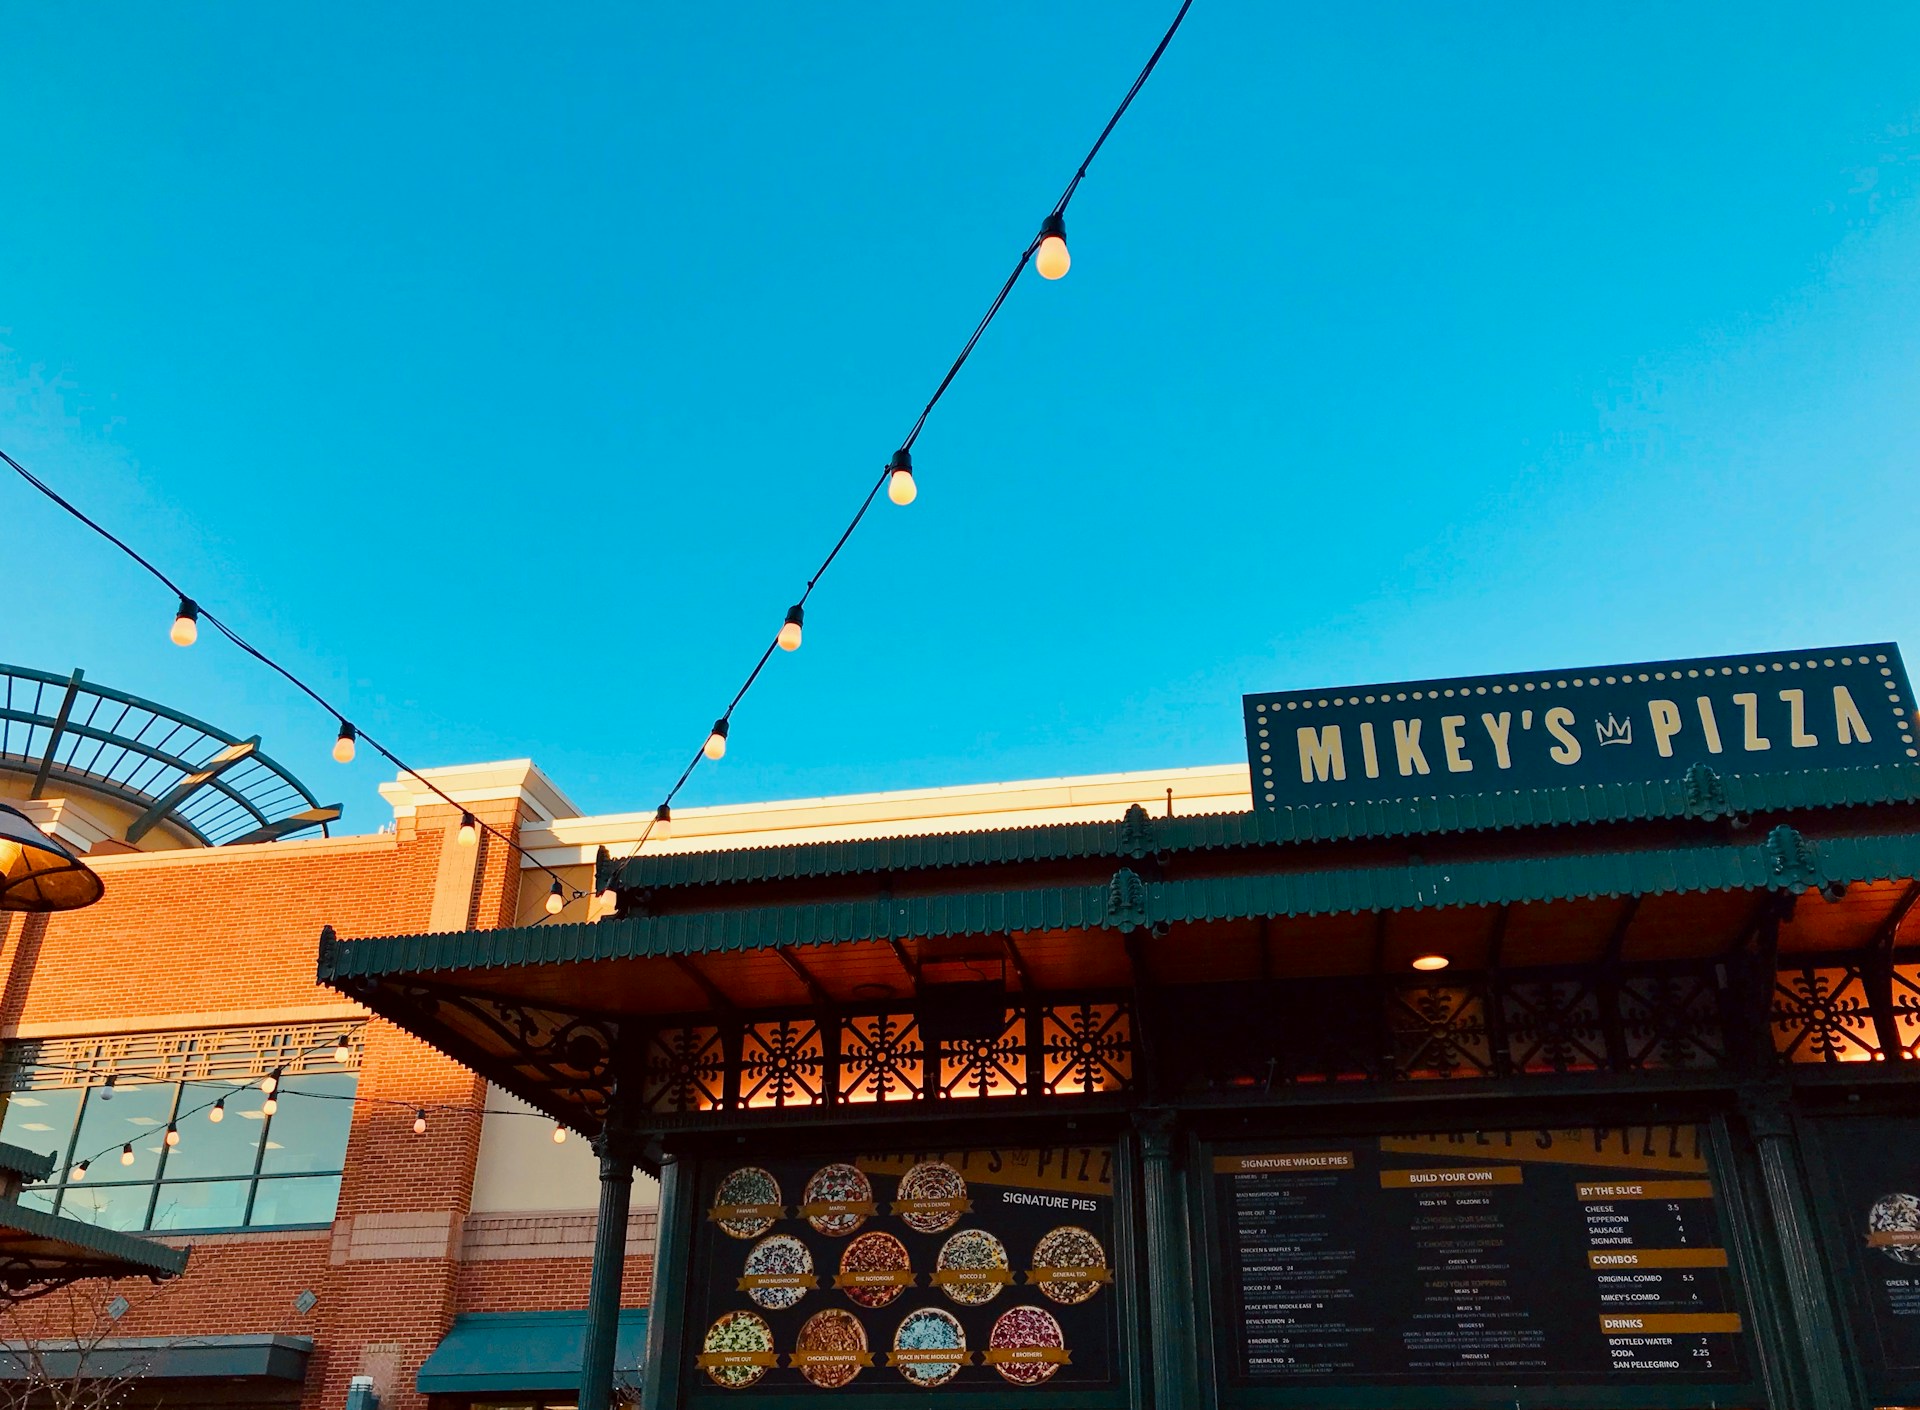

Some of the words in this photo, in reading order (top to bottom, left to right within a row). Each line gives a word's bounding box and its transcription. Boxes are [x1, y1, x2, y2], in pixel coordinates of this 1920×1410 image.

[1296, 706, 1583, 783] MIKEY'S
[1648, 685, 1873, 758] PIZZA
[1241, 1159, 1292, 1168] SIGNATURE
[1292, 1157, 1327, 1167] WHOLE
[1328, 1156, 1348, 1165] PIES
[1410, 1174, 1437, 1183] BUILD
[1438, 1173, 1466, 1182] YOUR
[1467, 1172, 1493, 1181] OWN
[1580, 1187, 1593, 1196] BY
[1594, 1186, 1614, 1195] THE
[1615, 1185, 1643, 1195] SLICE
[1002, 1191, 1069, 1209] SIGNATURE
[1071, 1198, 1097, 1212] PIES
[1585, 1205, 1614, 1213] CHEESE
[1667, 1203, 1680, 1211] 3.5
[1587, 1216, 1629, 1224] PEPPERONI
[1676, 1214, 1682, 1222] 4
[1589, 1226, 1624, 1235] SAUSAGE
[1591, 1237, 1633, 1245] SIGNATURE
[1680, 1235, 1687, 1243] 4
[1592, 1255, 1638, 1265] COMBOS
[1597, 1275, 1632, 1283] ORIGINAL
[1633, 1274, 1662, 1282] COMBO
[1682, 1274, 1694, 1282] 5.5
[1886, 1279, 1909, 1287] GREEN
[1601, 1293, 1630, 1302] MIKEY'S
[1630, 1293, 1661, 1301] COMBO
[1691, 1293, 1697, 1301] 6
[1604, 1319, 1643, 1328] DRINKS
[1609, 1338, 1644, 1346] BOTTLED
[1644, 1337, 1672, 1345] WATER
[1702, 1337, 1707, 1345] 2
[1611, 1349, 1634, 1357] SODA
[1692, 1349, 1709, 1357] 2.25
[1612, 1361, 1630, 1369] SAN
[1631, 1360, 1680, 1369] PELLEGRINO
[1706, 1360, 1712, 1368] 3
